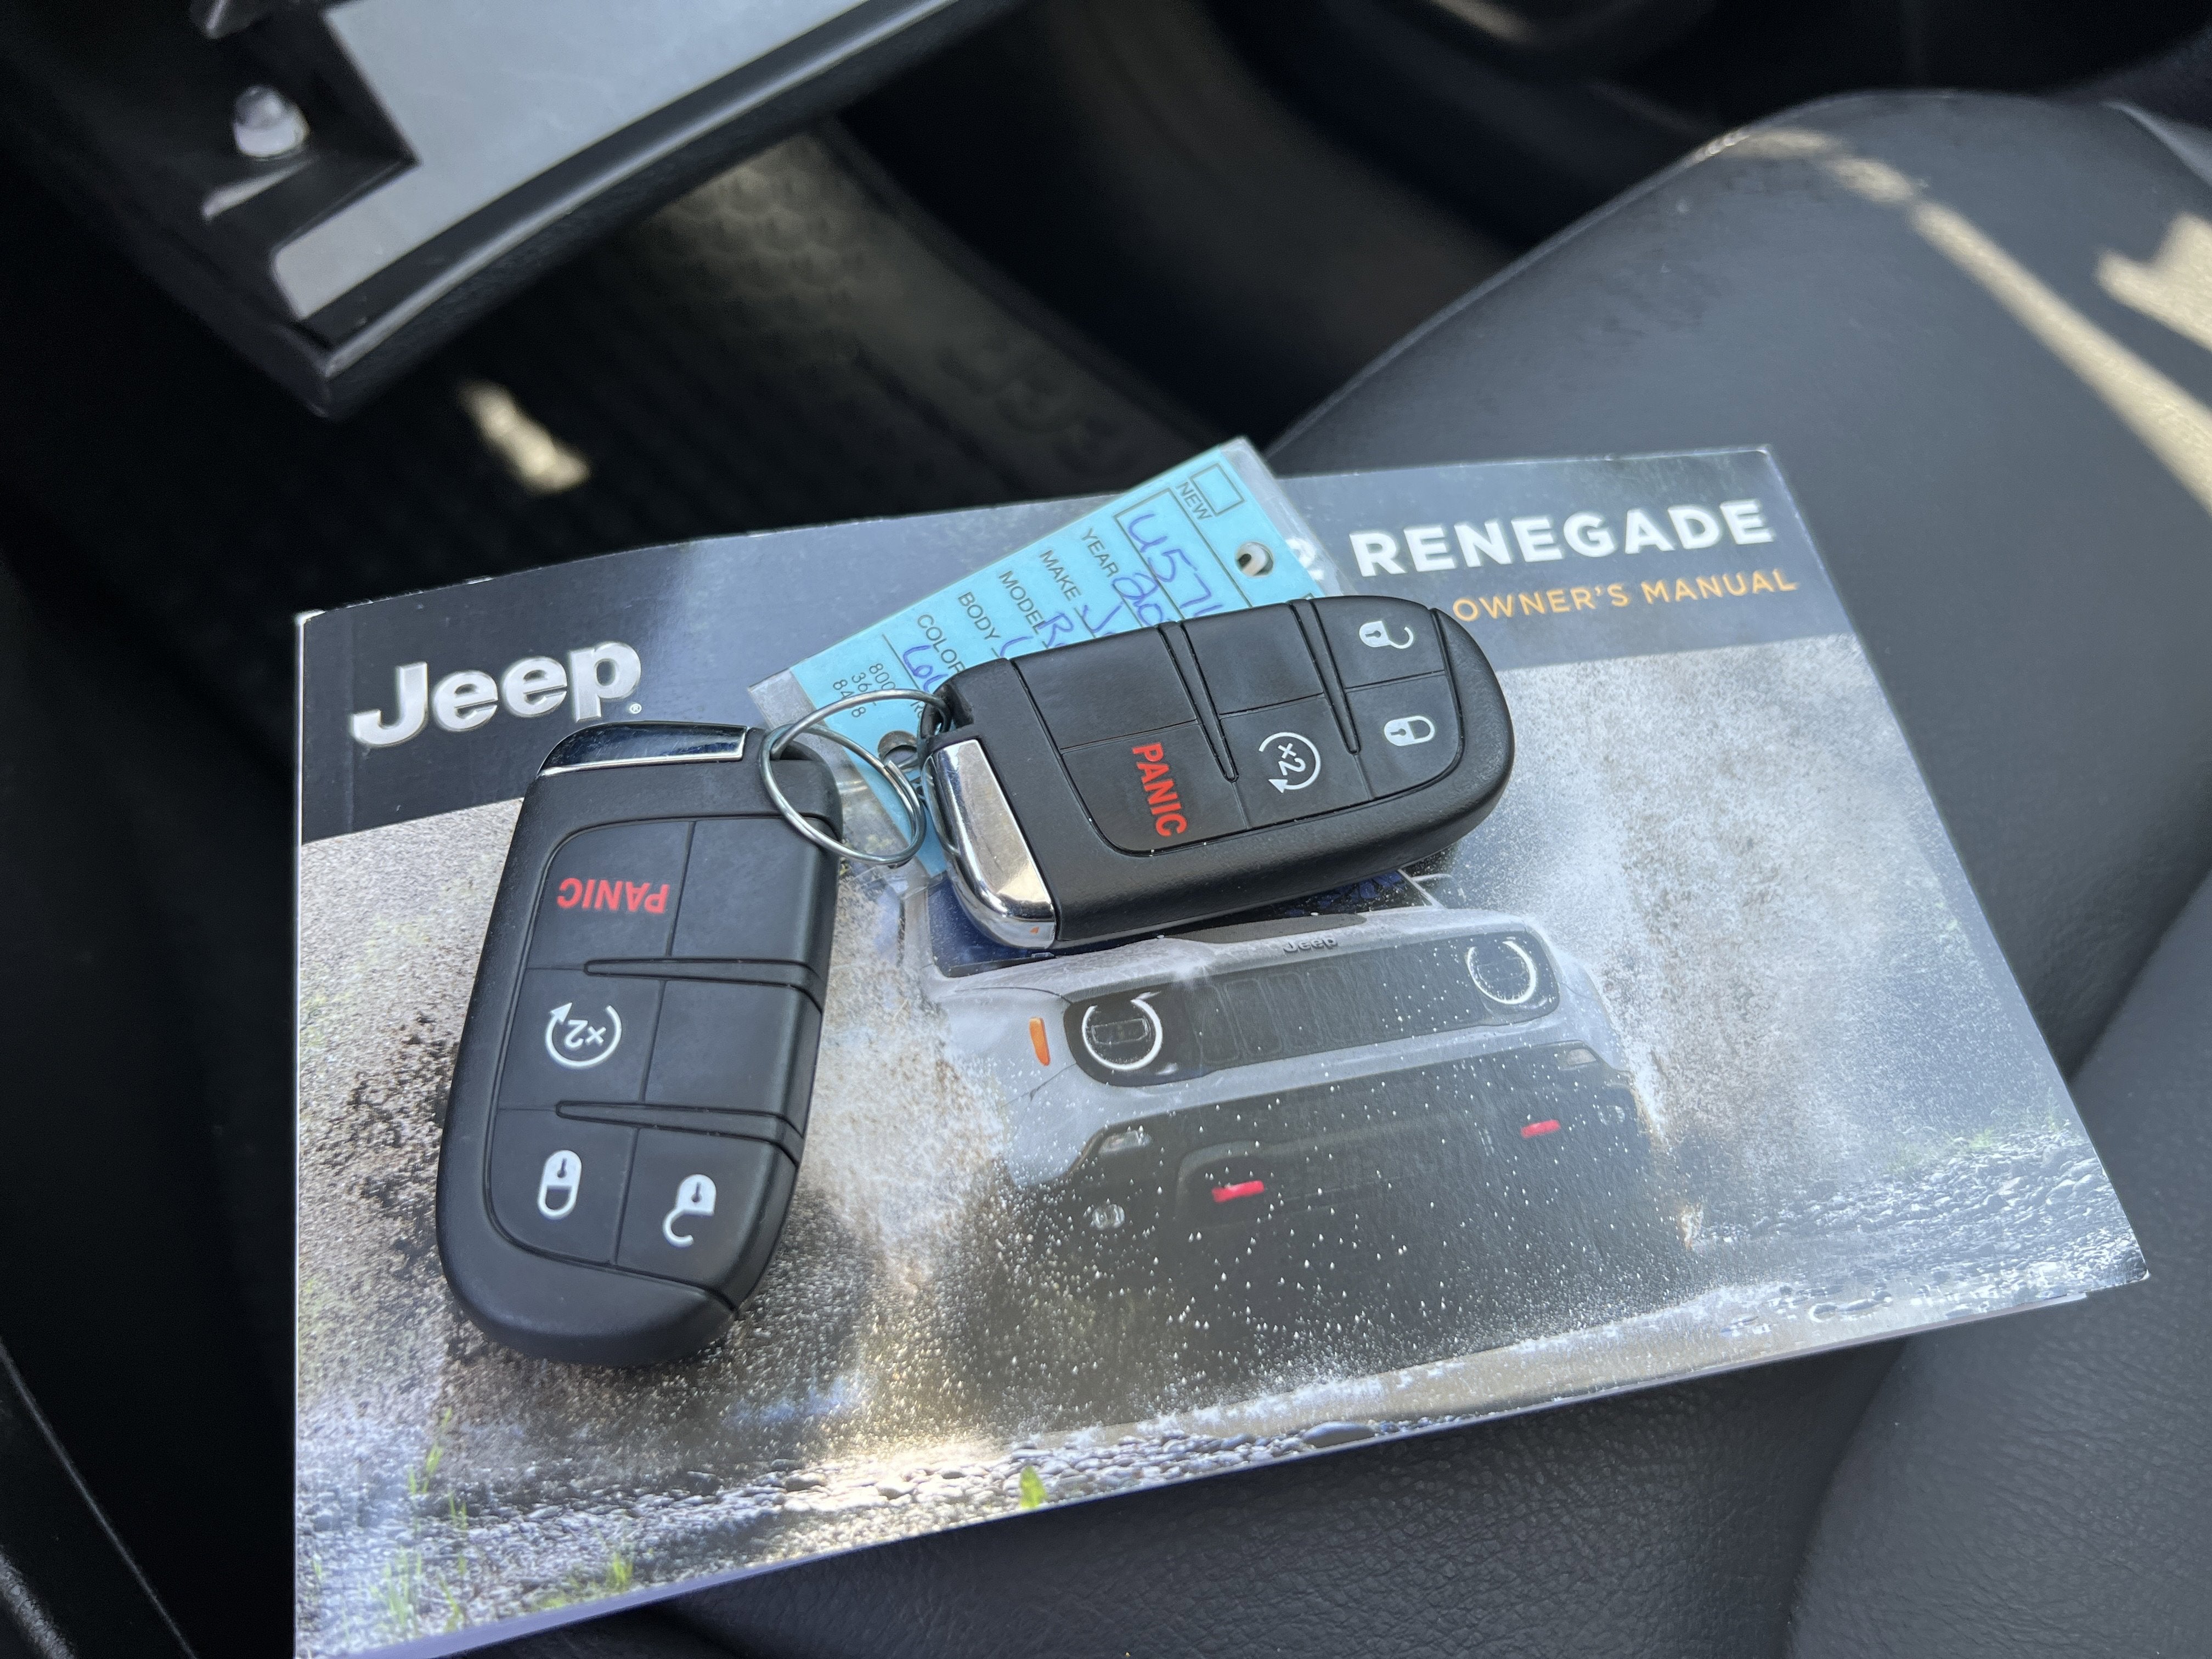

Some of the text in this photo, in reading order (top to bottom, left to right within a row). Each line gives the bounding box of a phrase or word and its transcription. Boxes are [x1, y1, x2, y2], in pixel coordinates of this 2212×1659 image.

[1176, 482, 1212, 521] NEW
[1082, 528, 1120, 578] YEAR
[1349, 500, 1774, 577] RENEGADE
[1039, 549, 1082, 602] MAKE
[1453, 568, 1797, 622] OWNER'S MANUAL
[958, 592, 1001, 641] BODY
[998, 571, 1045, 635] MODEL
[917, 614, 966, 673] COLOR
[833, 679, 866, 718] 848
[1132, 742, 1188, 837] PANIC
[557, 877, 670, 914] PANIC
[1283, 935, 1338, 953] Jeep
